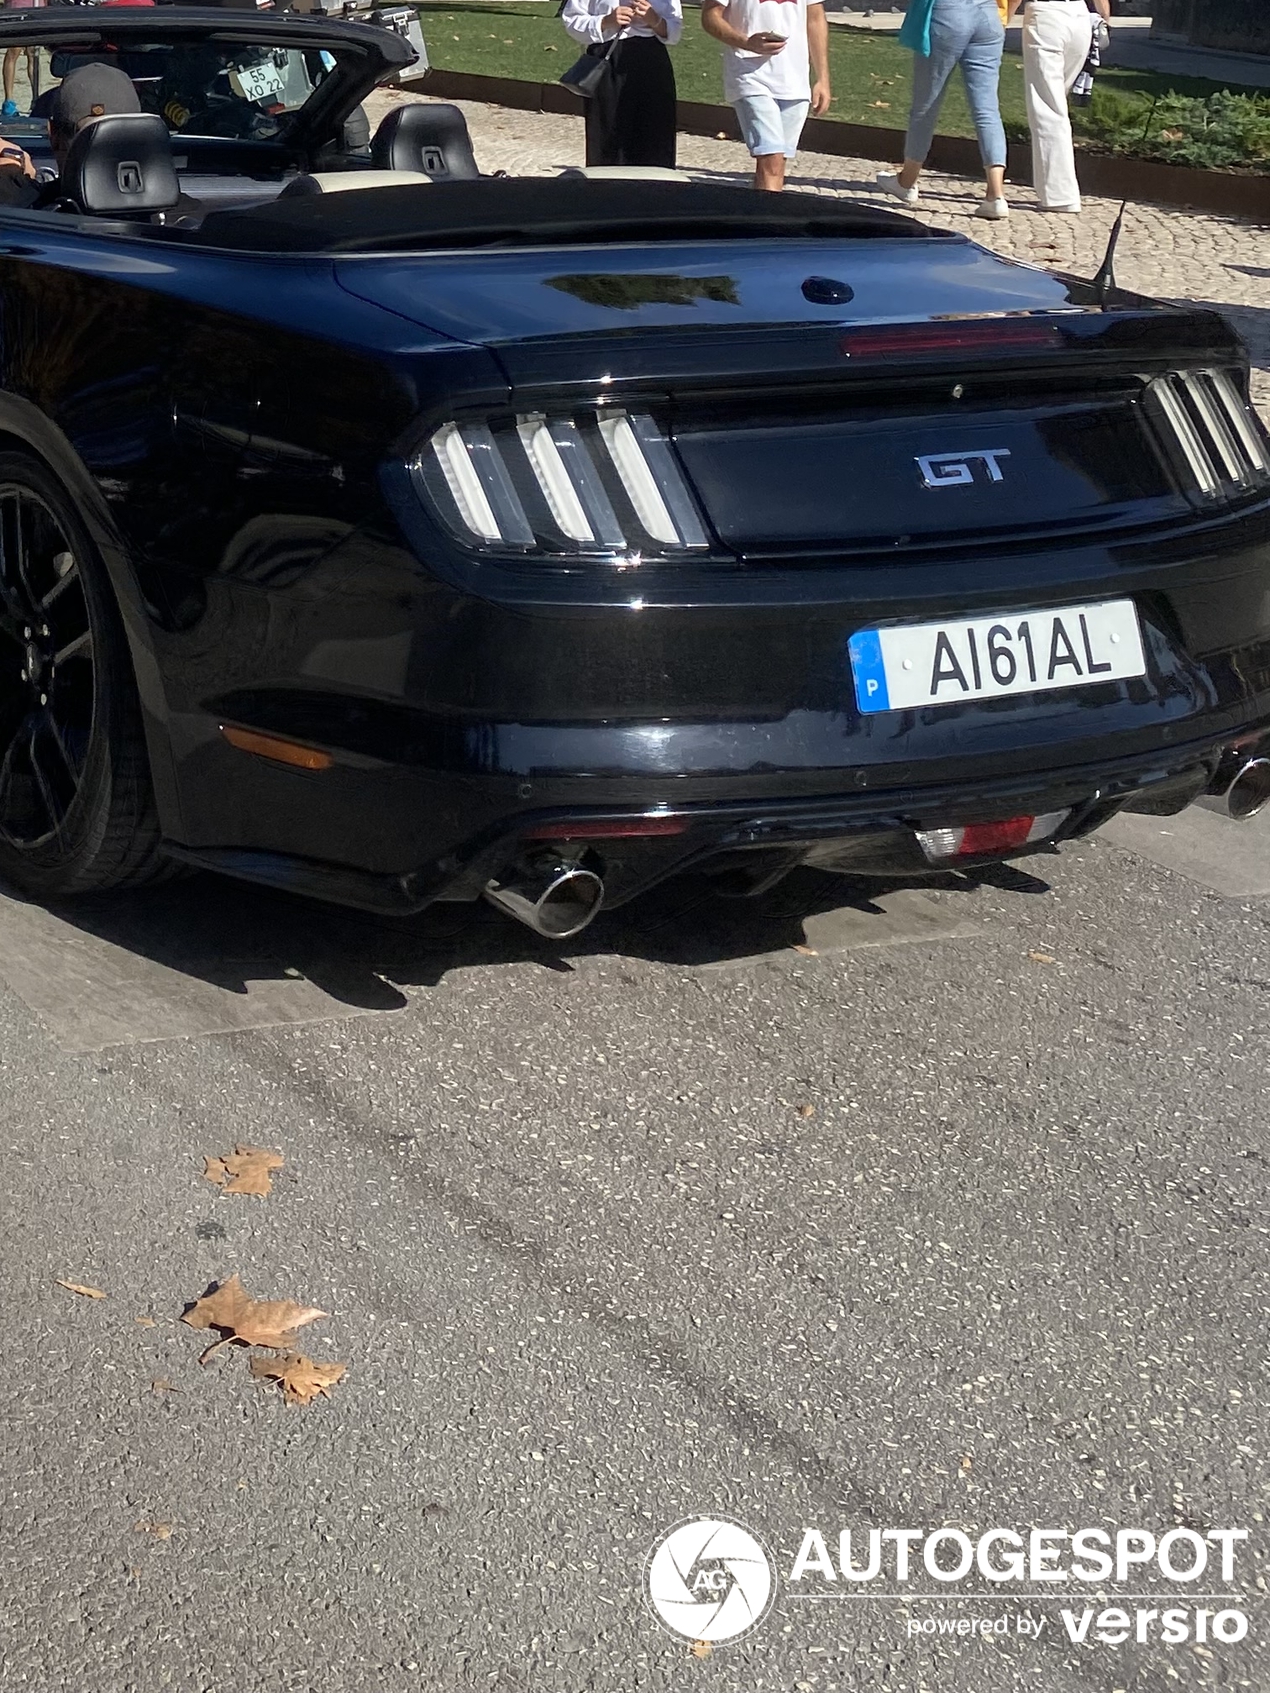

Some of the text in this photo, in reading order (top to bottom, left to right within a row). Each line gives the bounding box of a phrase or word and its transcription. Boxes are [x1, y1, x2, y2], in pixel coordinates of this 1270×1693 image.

[250, 67, 266, 83] 55
[266, 79, 282, 93] 22
[914, 448, 1011, 487] GT
[930, 614, 1112, 696] AI61AL
[866, 679, 879, 697] P
